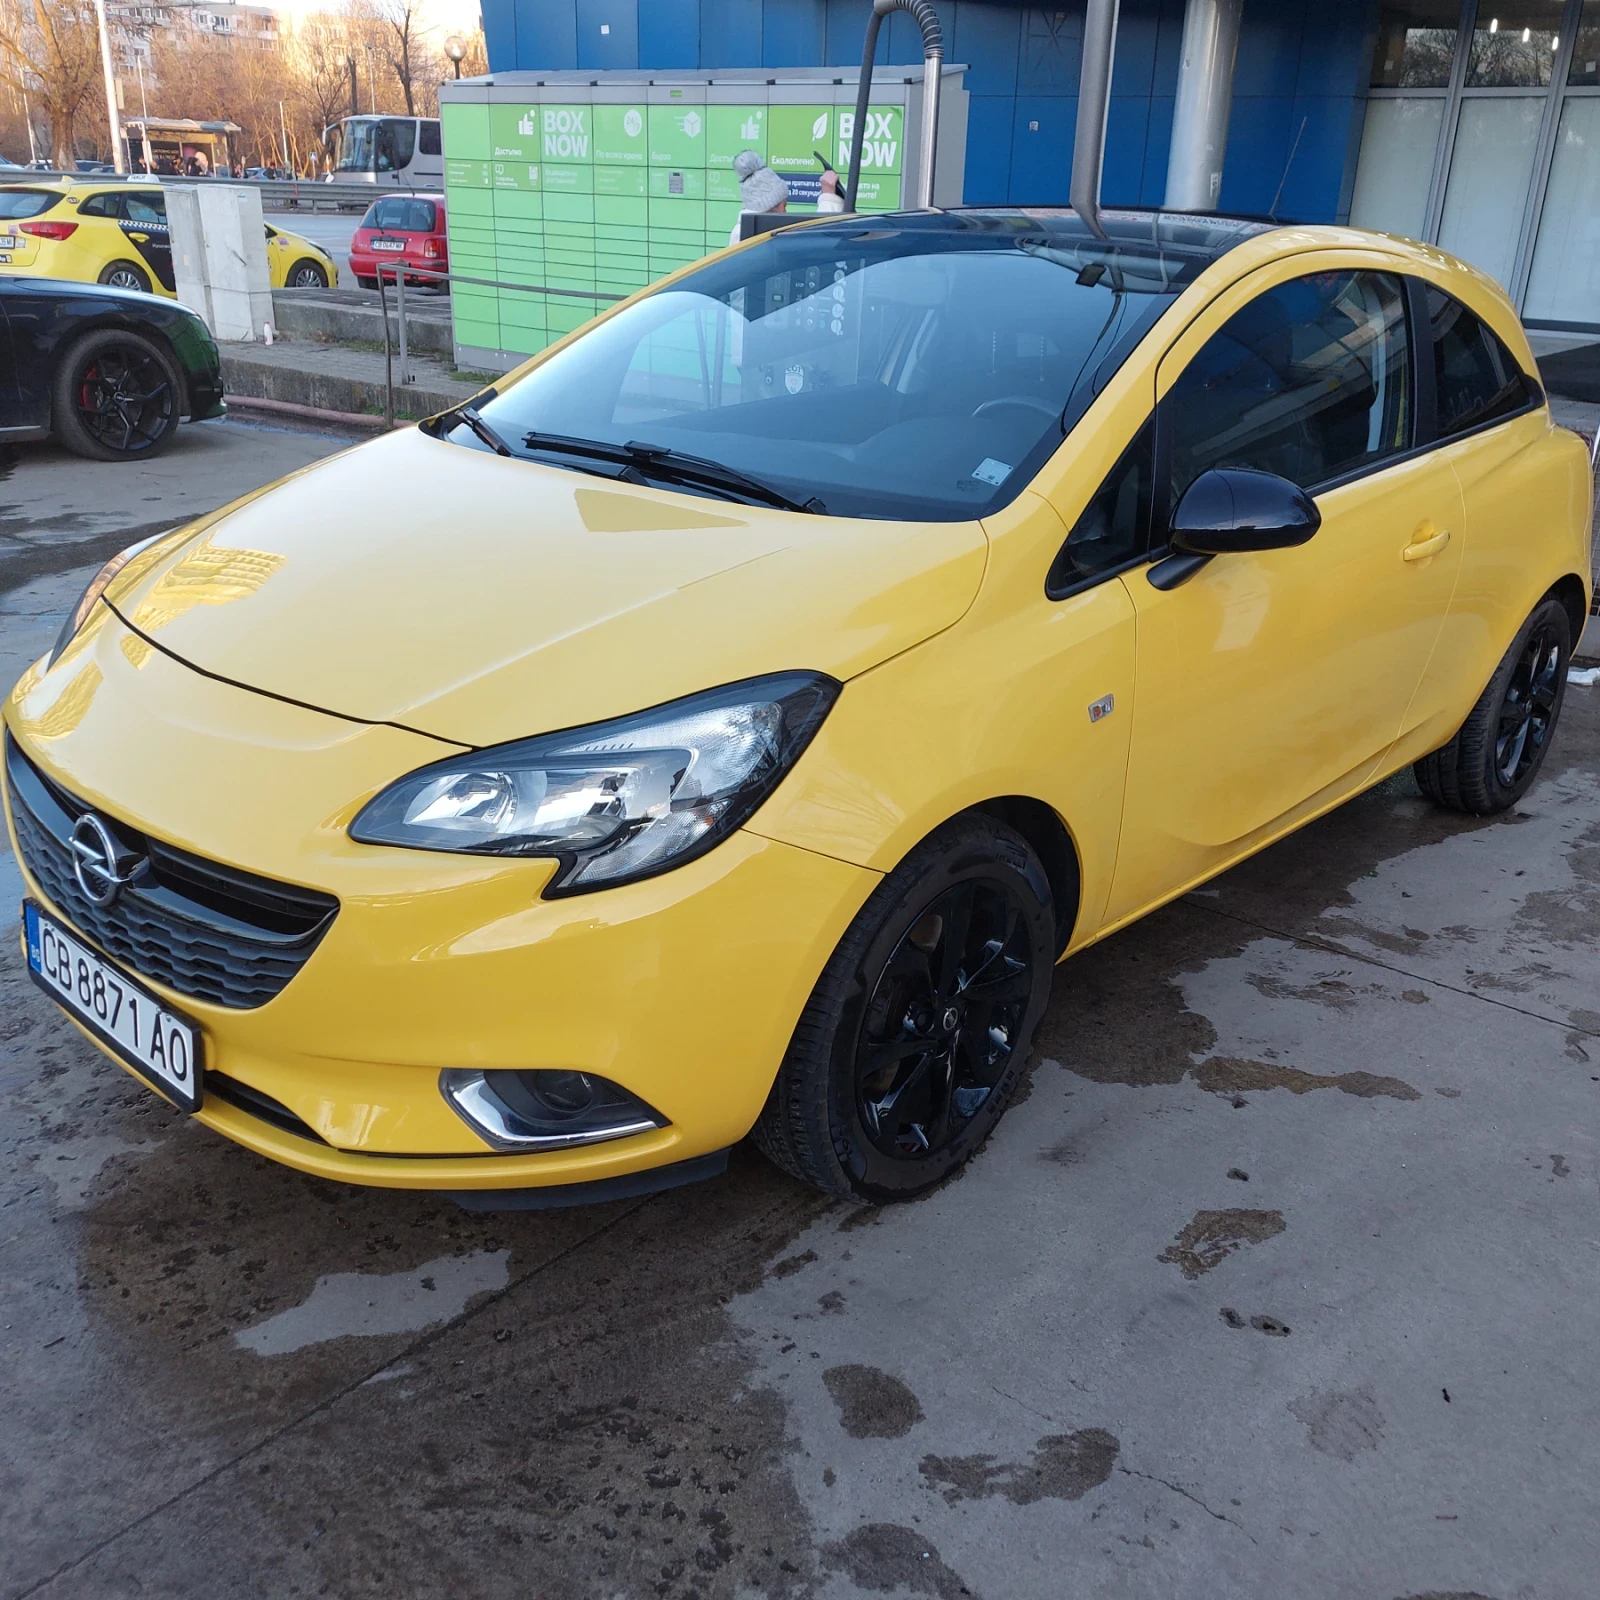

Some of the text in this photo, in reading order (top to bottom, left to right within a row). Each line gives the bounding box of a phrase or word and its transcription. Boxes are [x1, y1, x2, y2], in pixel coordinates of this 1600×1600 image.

[544, 110, 584, 133] BOX
[839, 112, 893, 139] BOX
[544, 134, 588, 158] NOW
[838, 140, 897, 167] NOW
[771, 155, 815, 166] Екологично
[792, 188, 799, 196] 20
[42, 927, 188, 1082] CB 8871 AO
